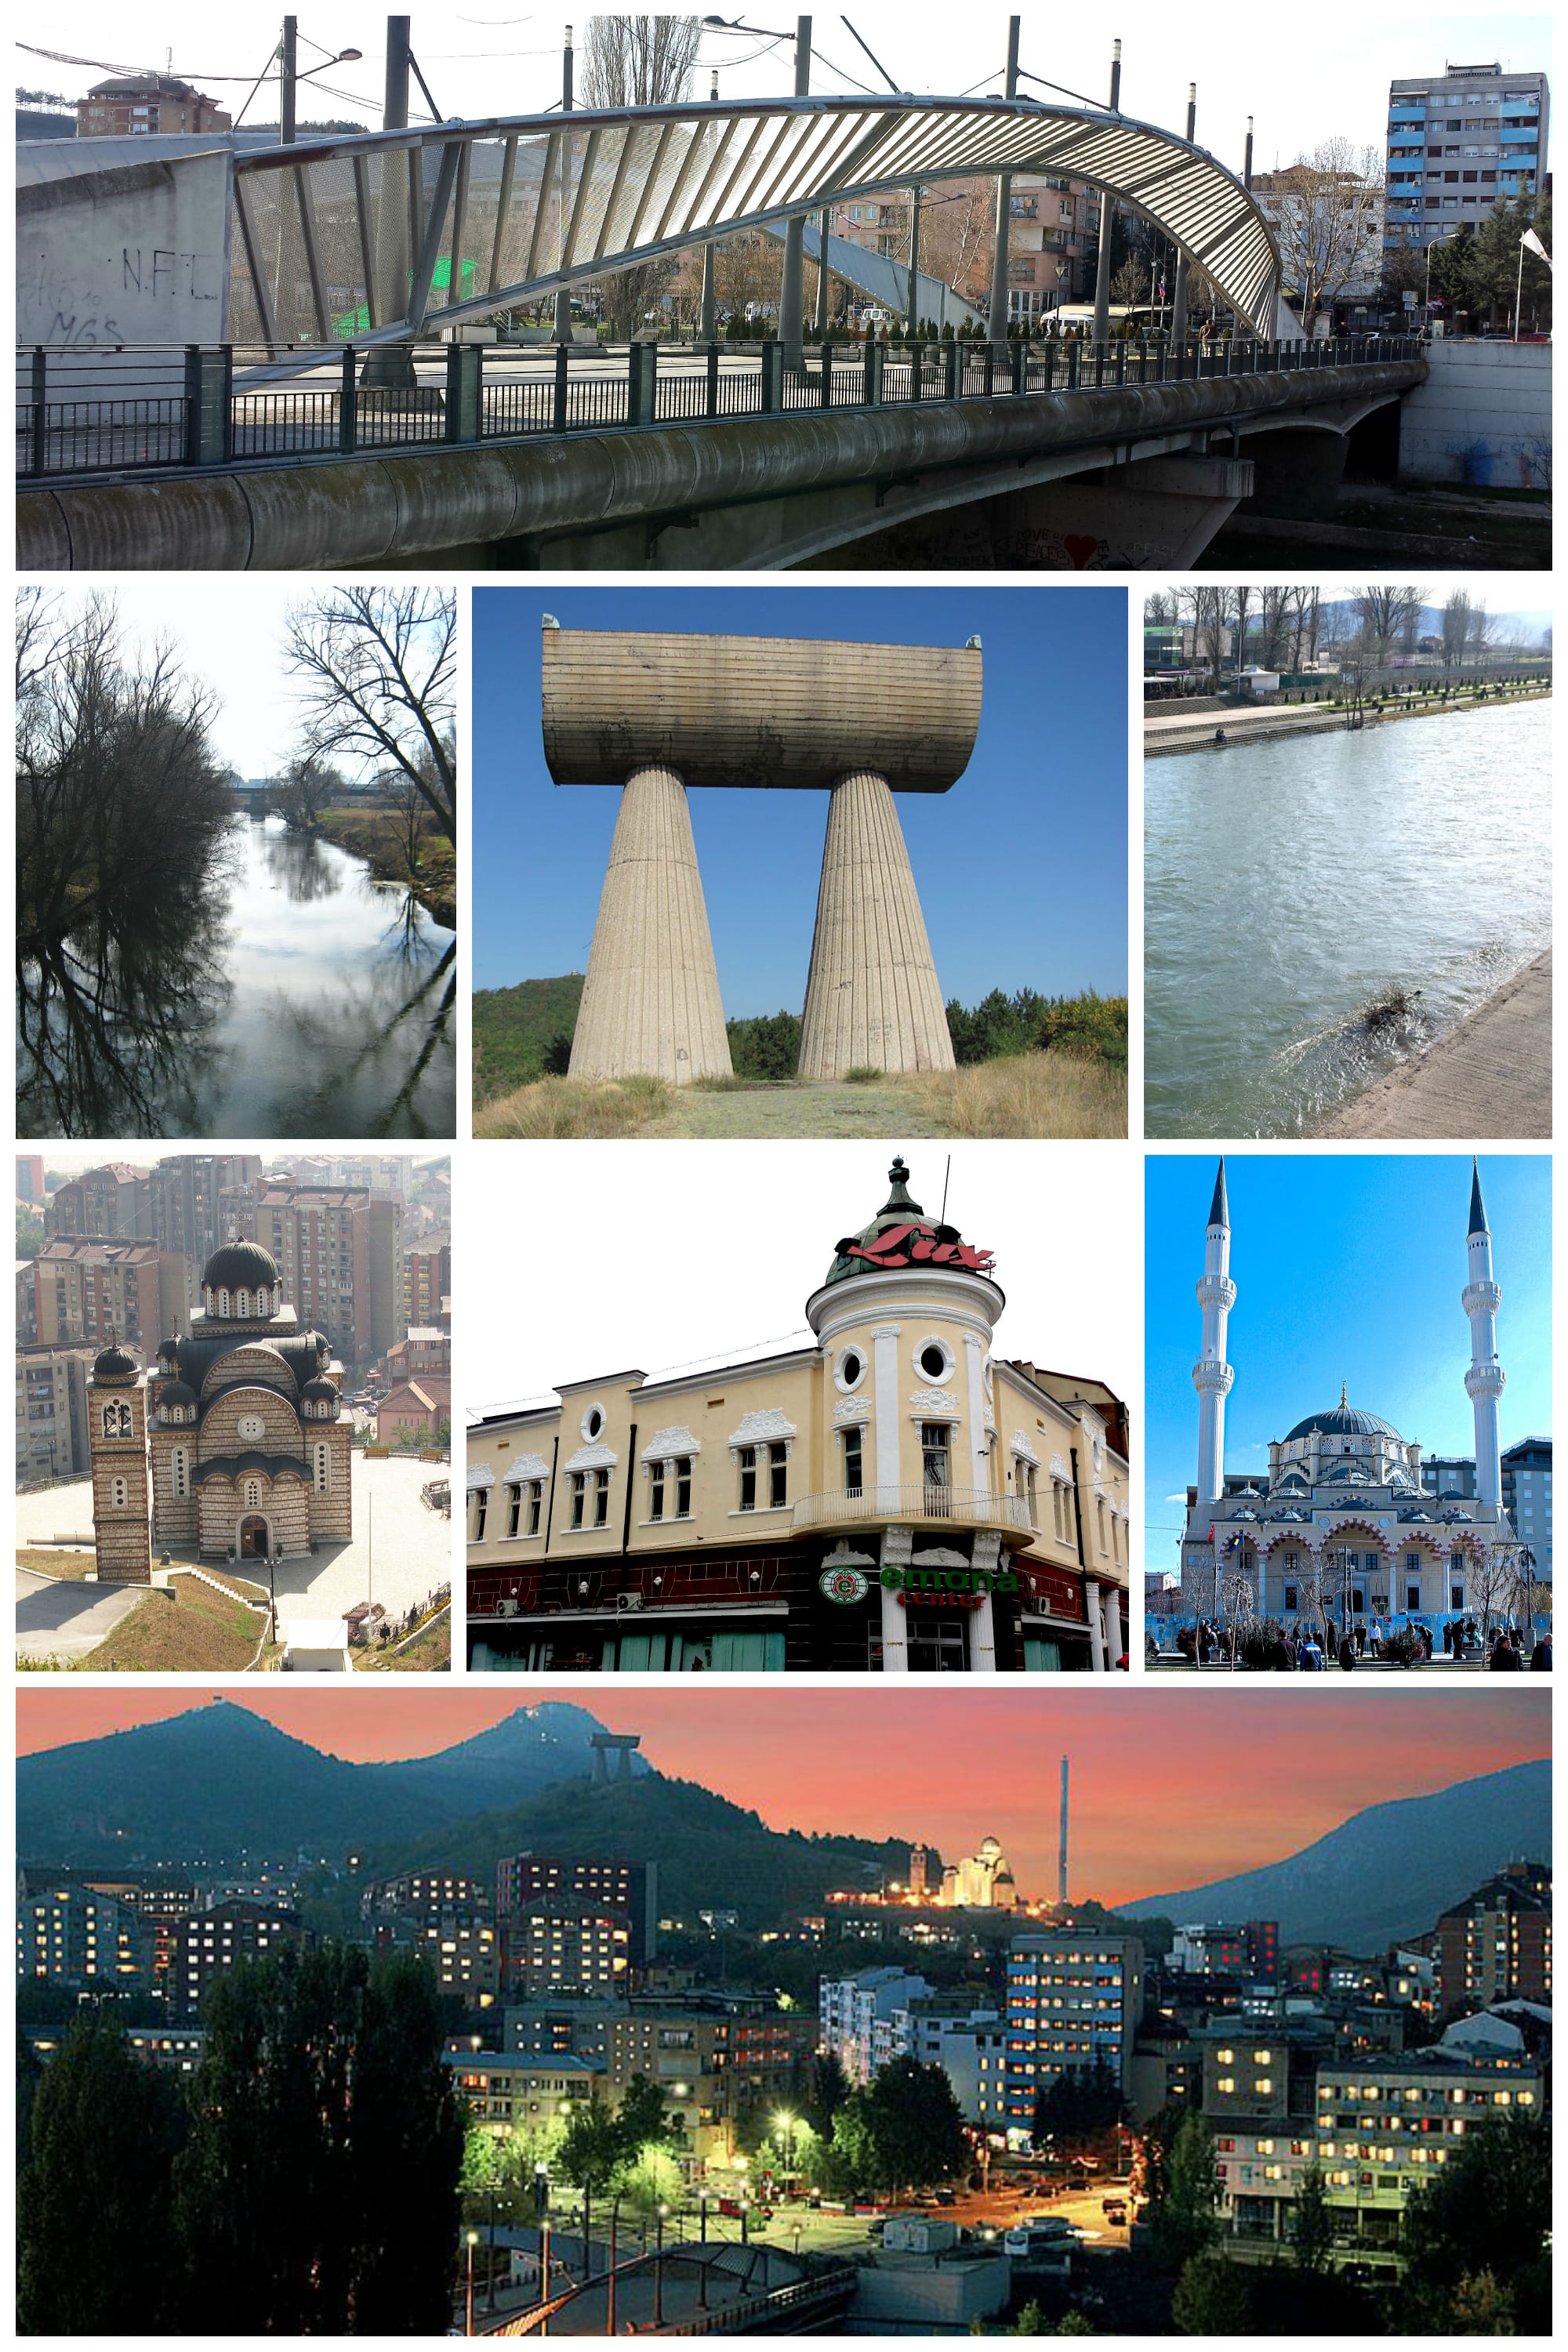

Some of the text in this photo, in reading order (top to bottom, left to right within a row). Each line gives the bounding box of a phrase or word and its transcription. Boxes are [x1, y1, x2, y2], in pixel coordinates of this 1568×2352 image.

[1017, 528, 1051, 542] LOVE
[1015, 542, 1058, 563] PEACE
[880, 1566, 1019, 1592] emona
[896, 1592, 987, 1609] center
